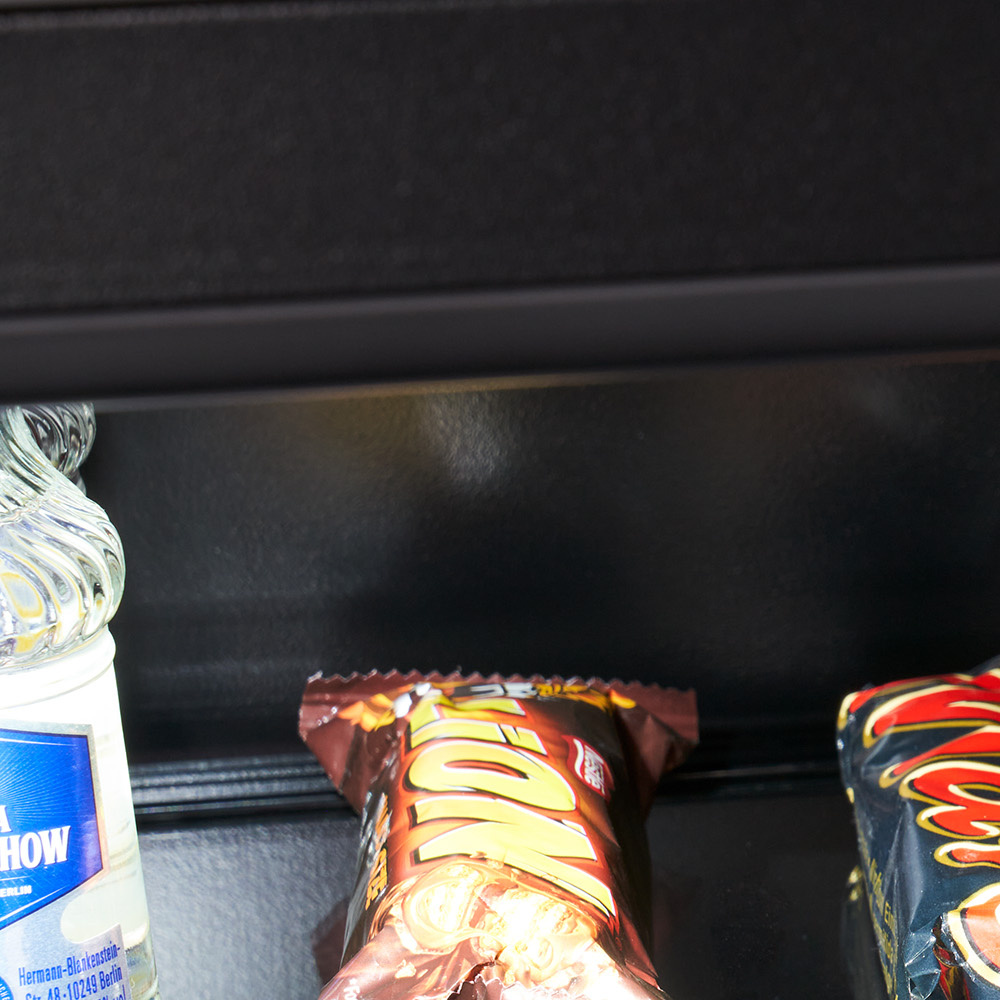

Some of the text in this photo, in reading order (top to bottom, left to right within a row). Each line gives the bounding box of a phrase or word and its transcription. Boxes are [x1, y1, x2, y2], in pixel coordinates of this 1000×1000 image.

[407, 692, 618, 920] LION
[0, 825, 71, 872] HOW
[0, 885, 32, 898] ERLIN
[18, 940, 121, 986] Hermann-Blankenstein-
[99, 964, 123, 990] Berlin
